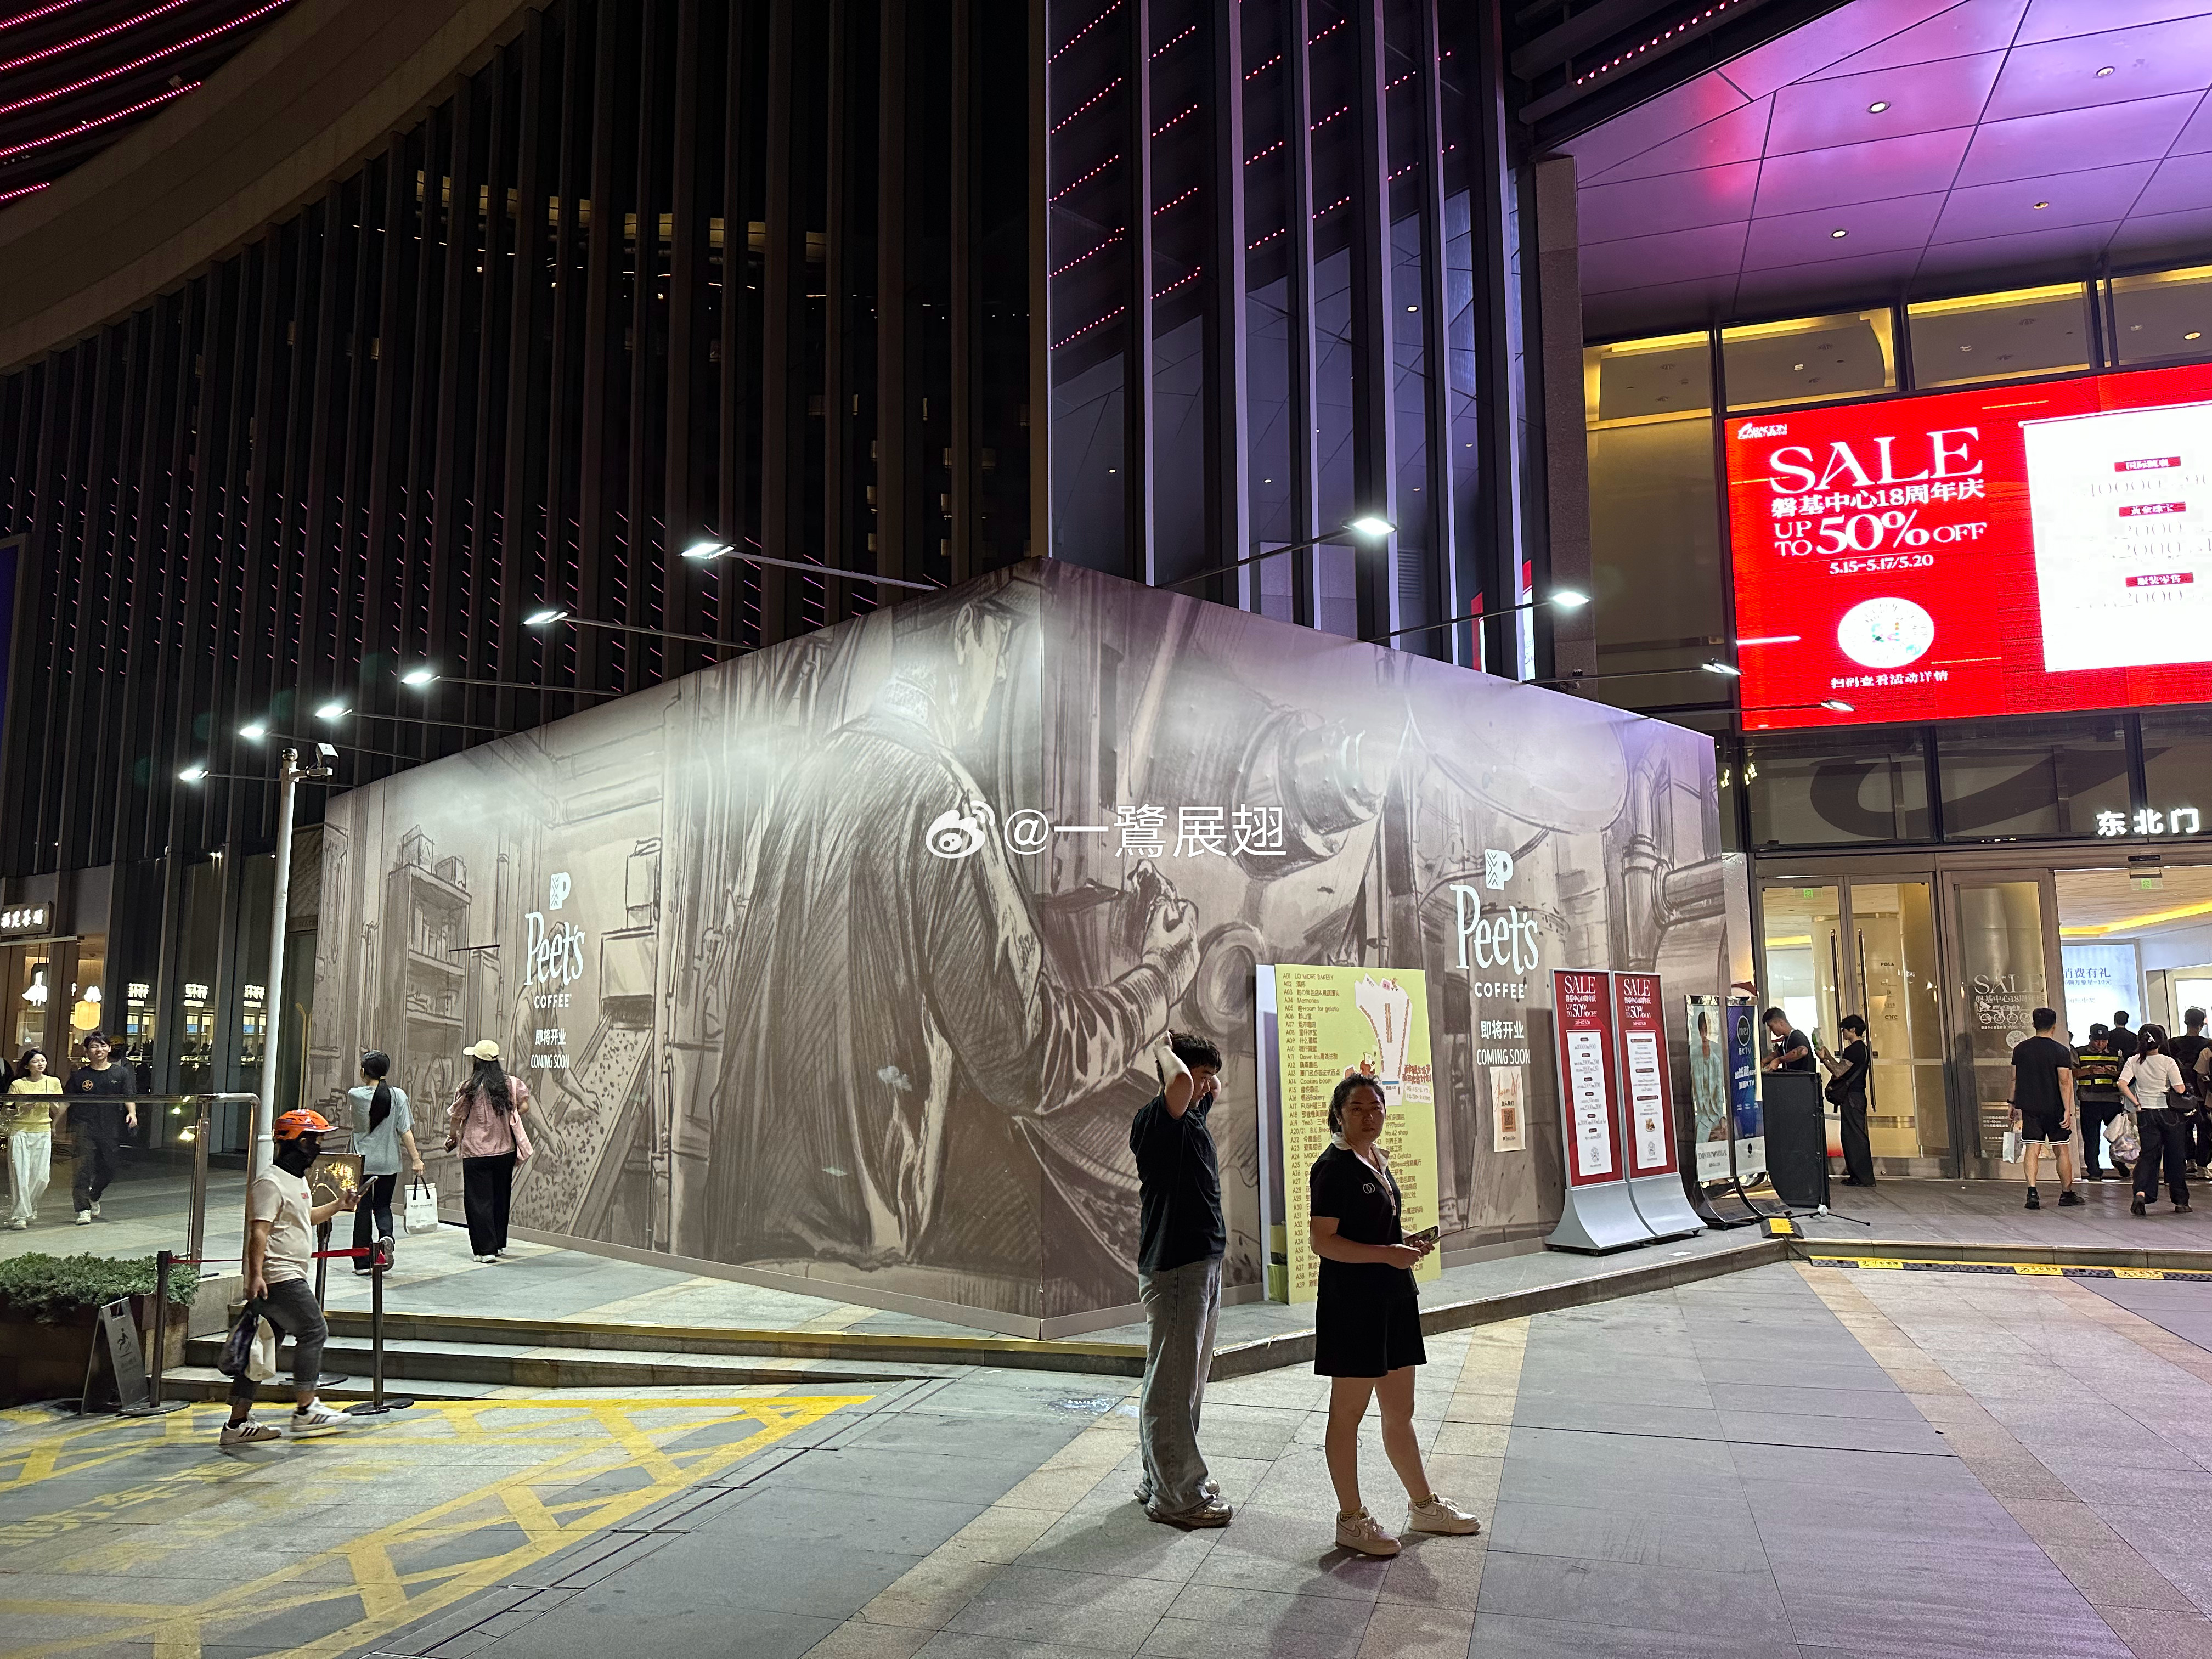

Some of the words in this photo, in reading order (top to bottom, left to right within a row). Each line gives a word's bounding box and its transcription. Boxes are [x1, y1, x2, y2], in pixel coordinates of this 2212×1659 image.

[1770, 427, 1982, 494] SALE
[1771, 478, 1985, 517] 磐基中心18周年庆
[1774, 521, 1812, 539] UP
[1816, 509, 1930, 555] 50%
[1933, 522, 1987, 543] OFF
[1775, 540, 1812, 556] TO
[1830, 554, 1934, 574] 5.15-5.17/5.20
[1831, 670, 1948, 689] 扫码查看活动详情
[2096, 808, 2200, 837] 东北门
[1449, 884, 1539, 975] Peet's
[524, 911, 585, 986] Peet's
[2064, 967, 2111, 978] 消费有礼
[1474, 982, 1525, 998] COFFEE
[1565, 975, 1596, 994] SALE
[1624, 978, 1650, 996] SALE
[1974, 974, 2044, 994] SALE
[534, 994, 569, 1009] COFFEE
[1572, 1003, 1589, 1018] 50%
[1630, 1005, 1645, 1019] 50%
[535, 1028, 566, 1045] 即将开业
[1481, 1020, 1525, 1040] 即将开业
[531, 1054, 553, 1069] COMING
[553, 1054, 569, 1068] SOON
[1476, 1049, 1508, 1065] COMING
[1509, 1049, 1531, 1065] SOON
